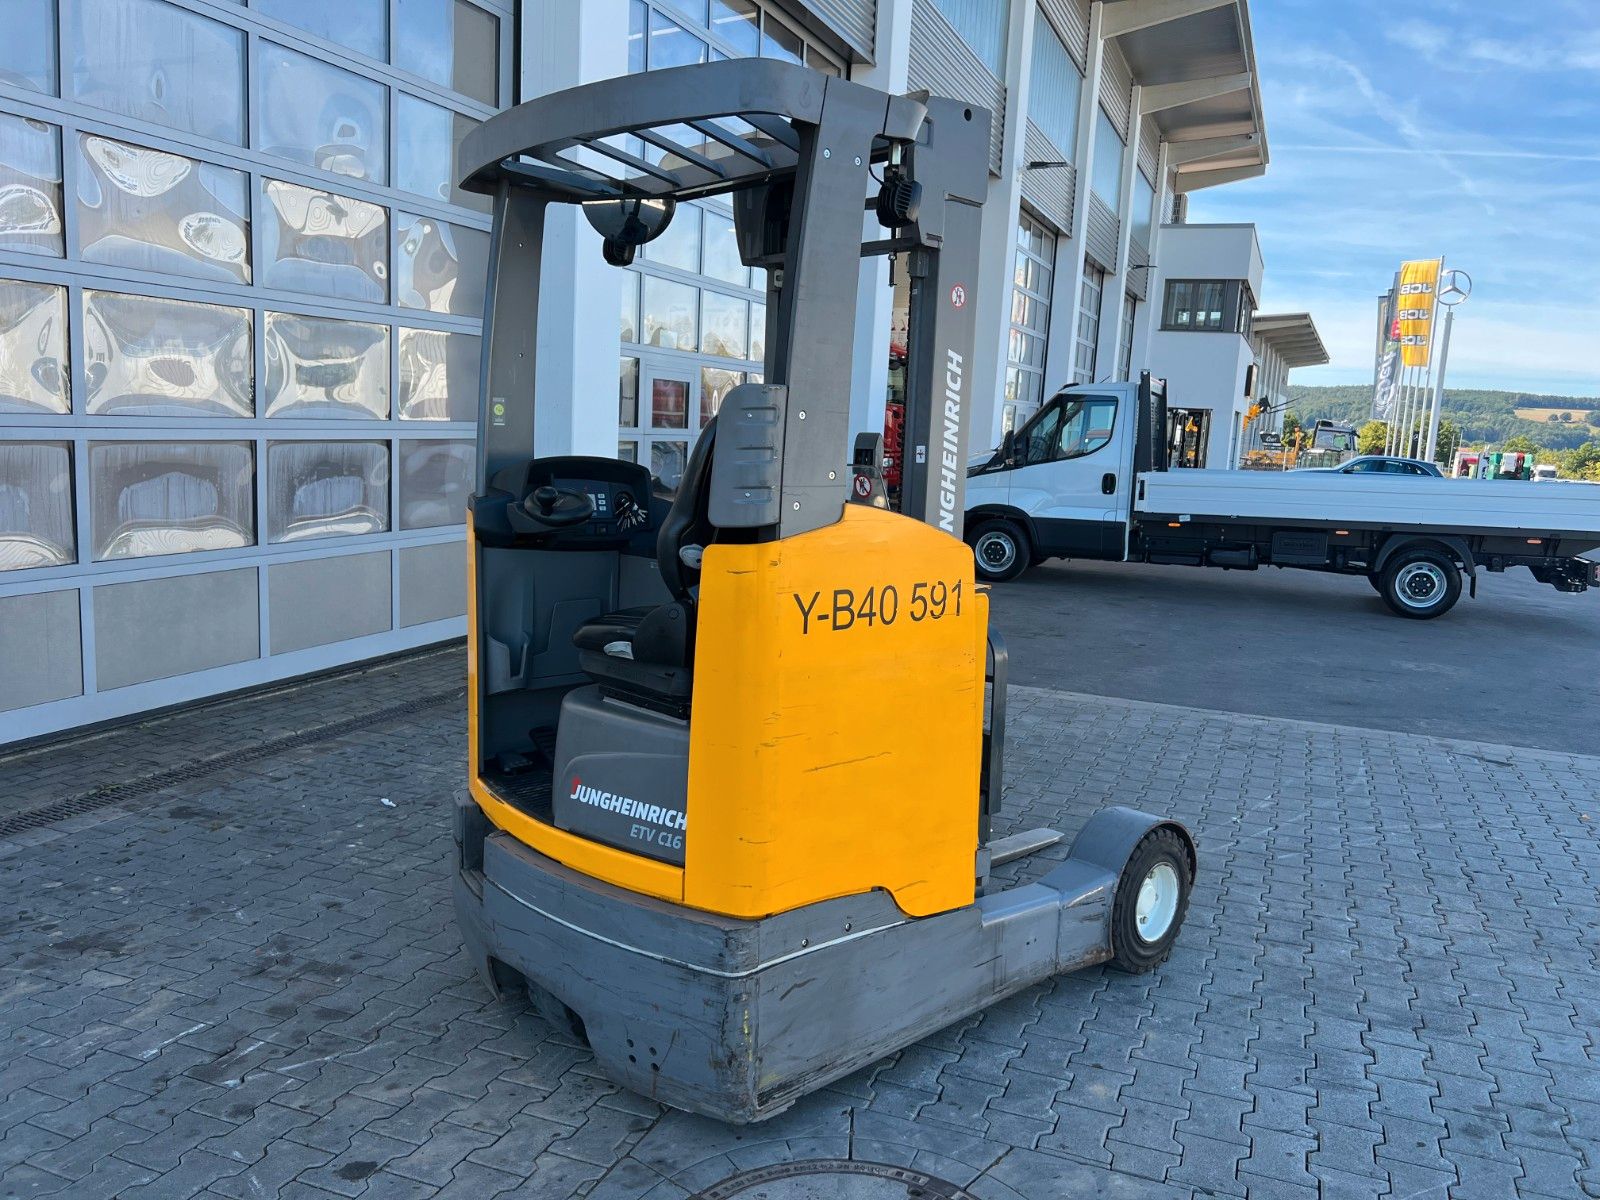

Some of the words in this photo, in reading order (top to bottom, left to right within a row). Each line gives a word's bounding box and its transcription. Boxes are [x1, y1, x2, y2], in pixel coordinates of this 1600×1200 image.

[939, 349, 963, 533] NGHEINRICH
[793, 584, 899, 635] Y-B40
[910, 579, 962, 622] 591
[570, 779, 687, 831] JUNGHEINRICH
[629, 823, 657, 842] ETV
[657, 832, 683, 850] C16
